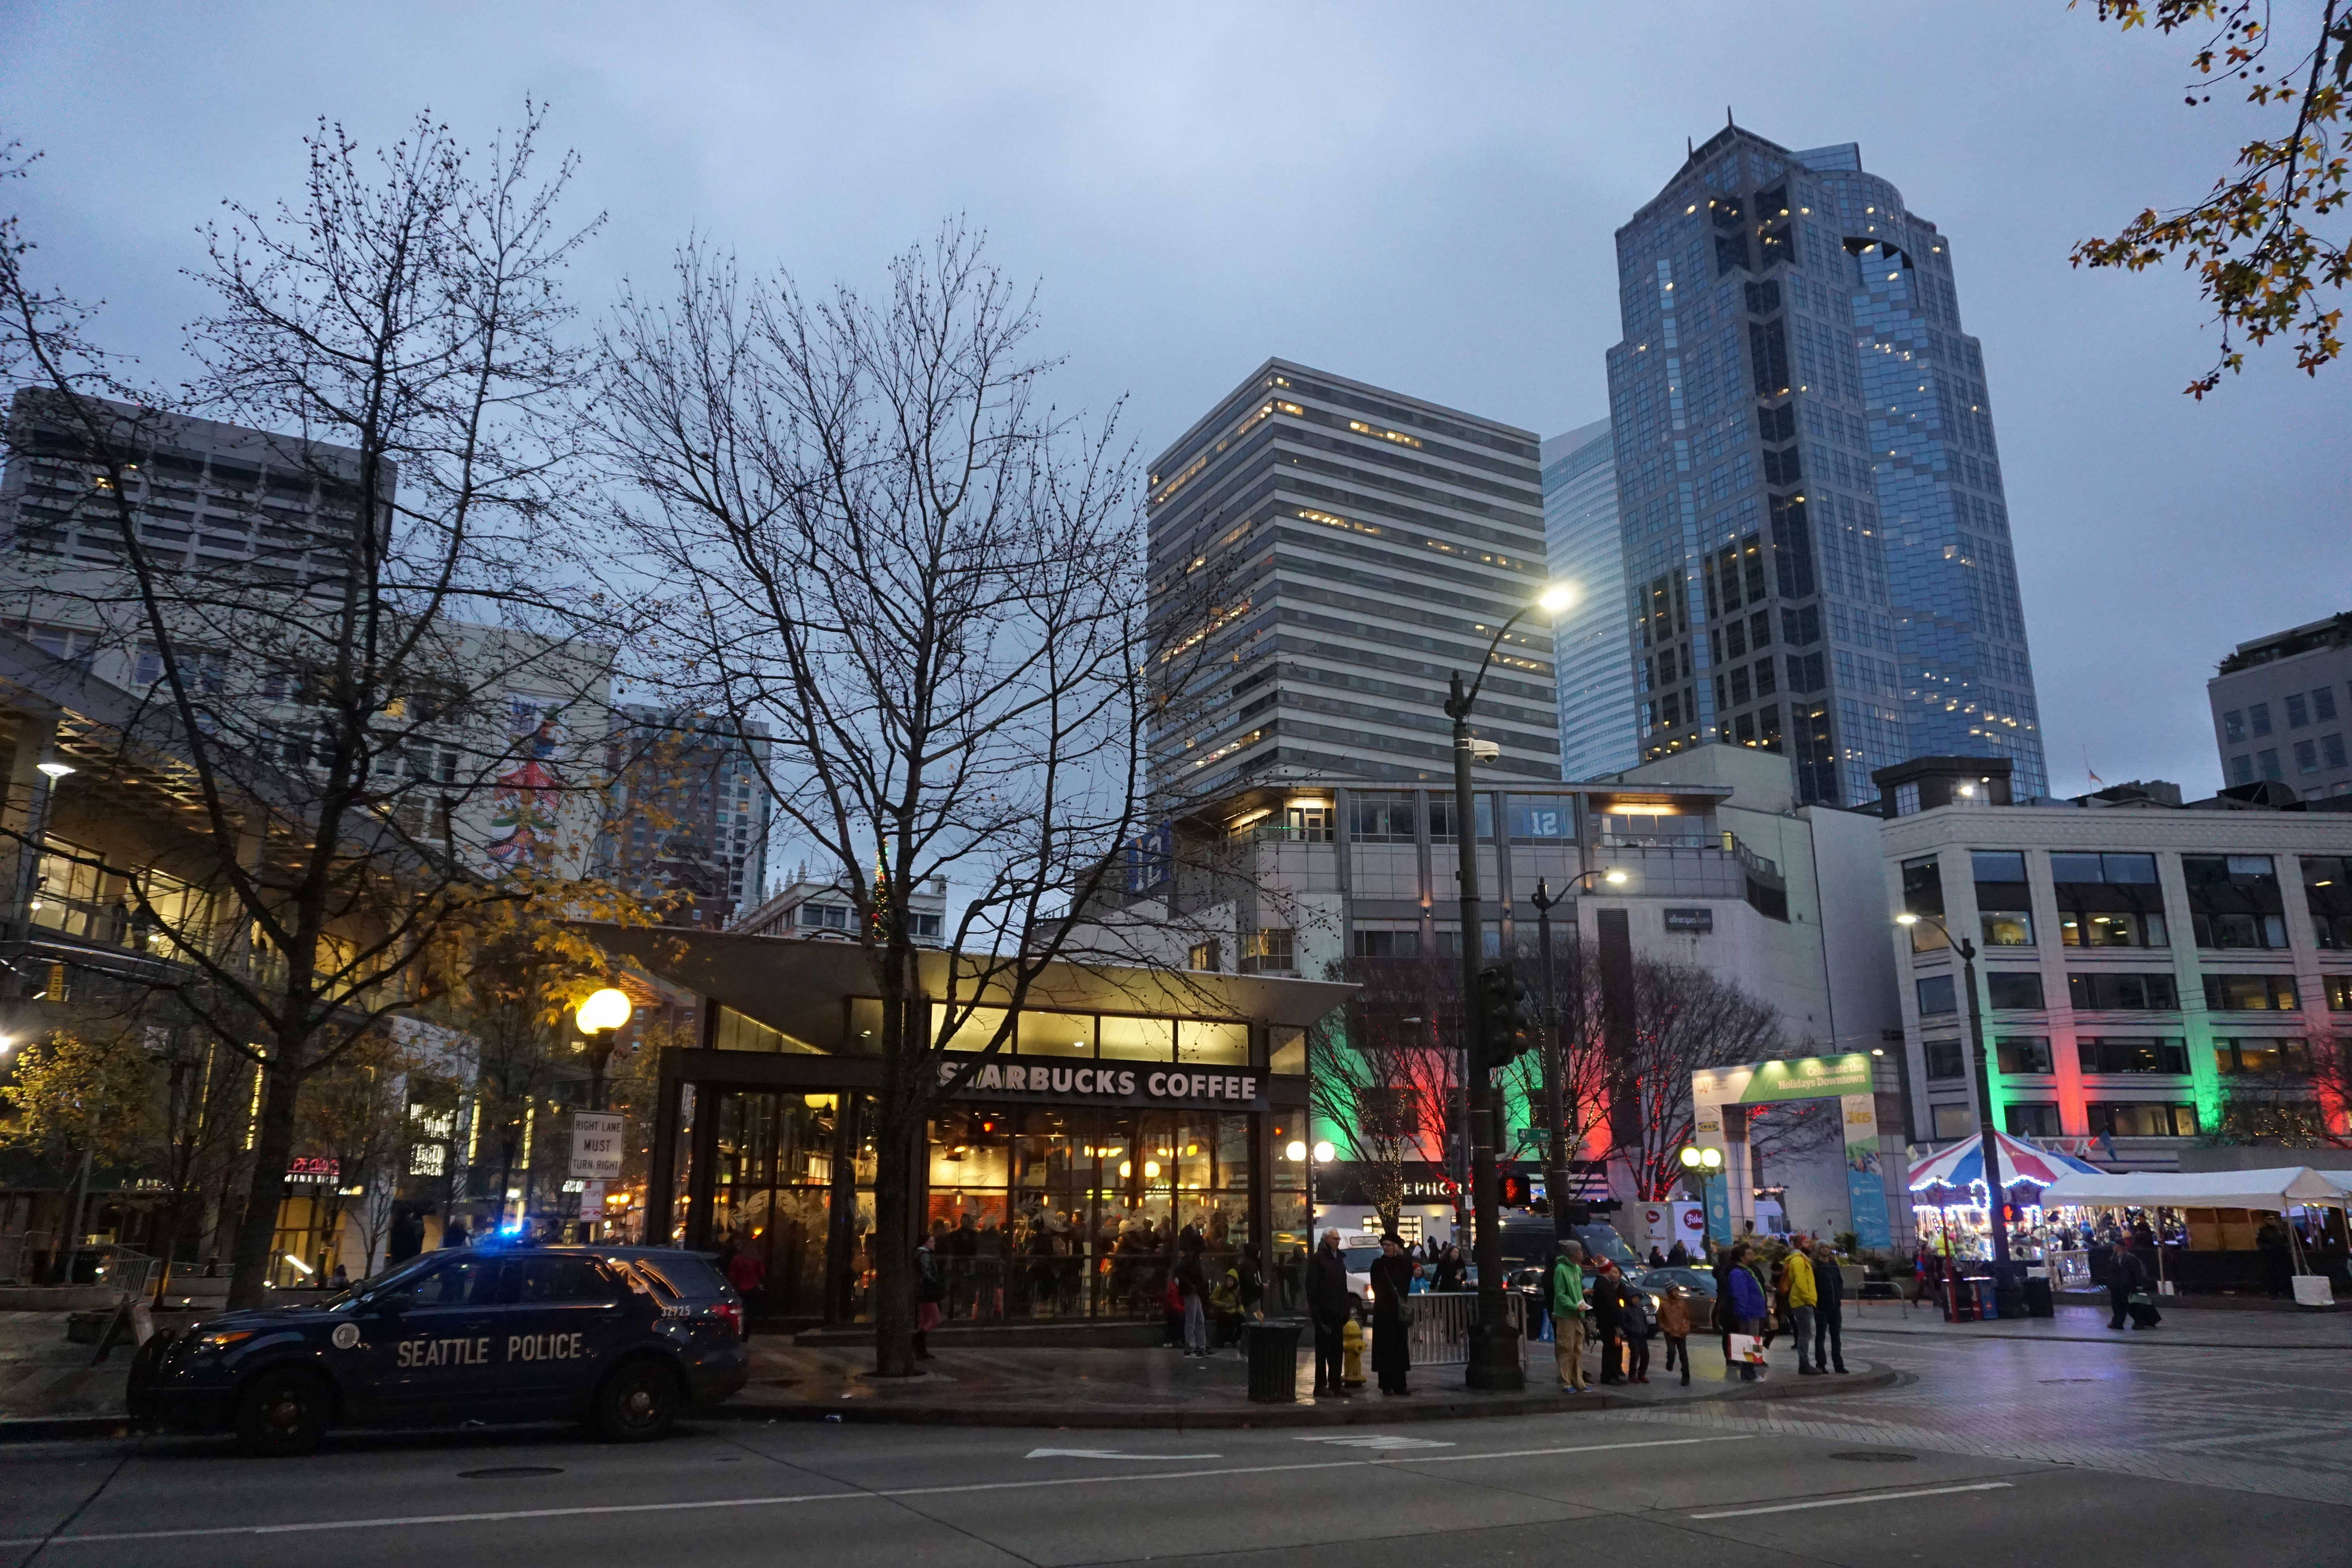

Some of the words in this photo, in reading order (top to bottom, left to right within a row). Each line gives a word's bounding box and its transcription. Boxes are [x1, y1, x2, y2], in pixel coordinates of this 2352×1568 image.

[1532, 812, 1557, 835] 12
[1136, 835, 1162, 891] 12
[1807, 1065, 1847, 1076] Celebrate
[1849, 1062, 1864, 1072] the
[937, 1062, 1135, 1095] SARBUCKS
[1149, 1072, 1256, 1099] COFFEE
[1779, 1079, 1816, 1089] Holidays
[1817, 1075, 1866, 1087] Downtown
[576, 1120, 598, 1131] RIGHT
[602, 1122, 621, 1132] LANE
[584, 1140, 611, 1152] MUST
[573, 1159, 592, 1170] TURN
[597, 1160, 618, 1170] RIGHT
[284, 1174, 313, 1183] HINA
[1403, 1182, 1462, 1195] EPHOR
[1686, 1214, 1703, 1225] Fishe
[661, 1306, 690, 1317] 32725
[397, 1338, 489, 1367] SEATTLE
[508, 1333, 583, 1362] POLICE
